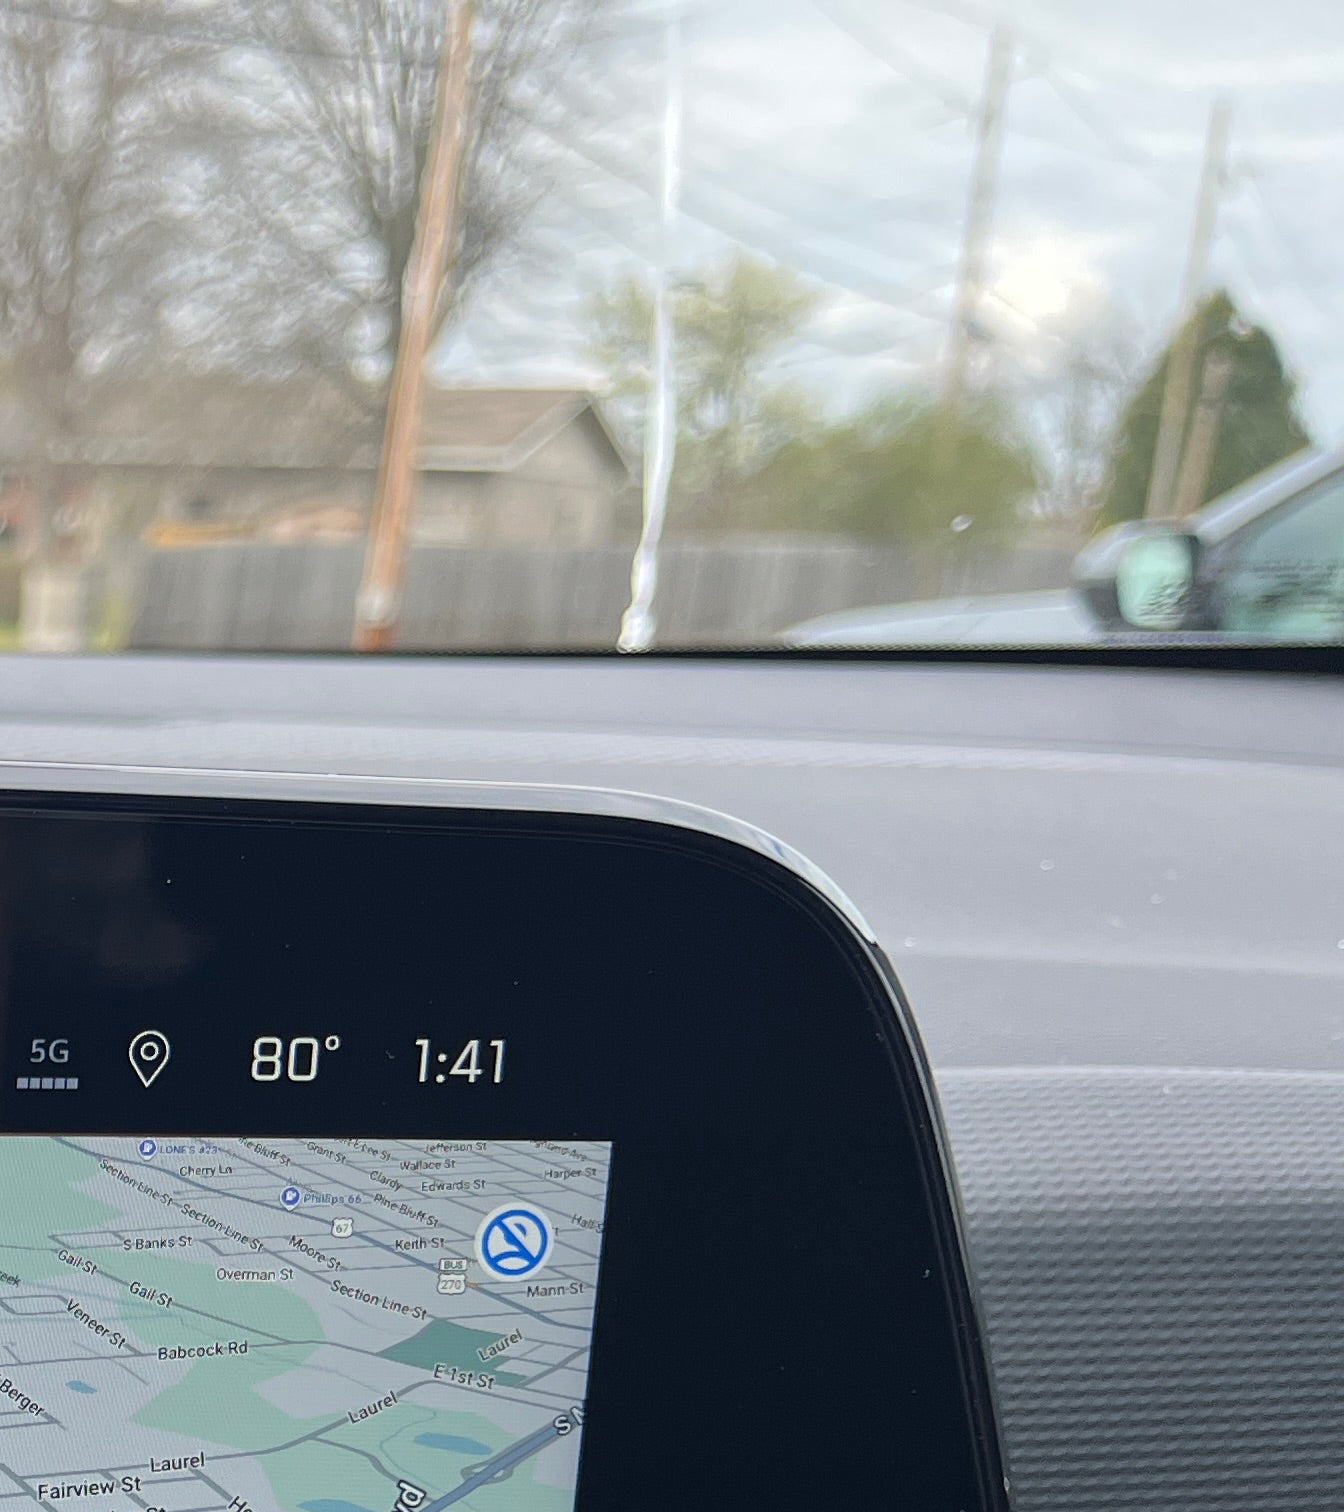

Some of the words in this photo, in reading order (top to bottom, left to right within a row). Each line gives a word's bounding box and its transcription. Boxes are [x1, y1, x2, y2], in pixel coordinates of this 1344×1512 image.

[29, 1039, 70, 1063] 5G
[415, 1039, 507, 1083] 1:41
[135, 1238, 176, 1250] Banks
[431, 1237, 445, 1249] St
[279, 1268, 294, 1280] St
[129, 1282, 157, 1302] Gail
[155, 1288, 173, 1309] St
[330, 1280, 379, 1305] Section
[381, 1299, 410, 1315] Line
[412, 1306, 428, 1320] St
[67, 1299, 110, 1337] Veneer
[109, 1332, 126, 1350] St
[158, 1345, 222, 1361] Babcock
[228, 1341, 248, 1355] Rd
[477, 1329, 523, 1361] Laurel
[434, 1365, 446, 1379] E
[449, 1368, 472, 1386] 1st
[477, 1374, 494, 1390] St
[0, 1380, 45, 1417] Berger
[348, 1391, 398, 1424] Laurel
[150, 1452, 206, 1474] Laurel
[38, 1479, 115, 1500] Fairview
[121, 1476, 142, 1492] St
